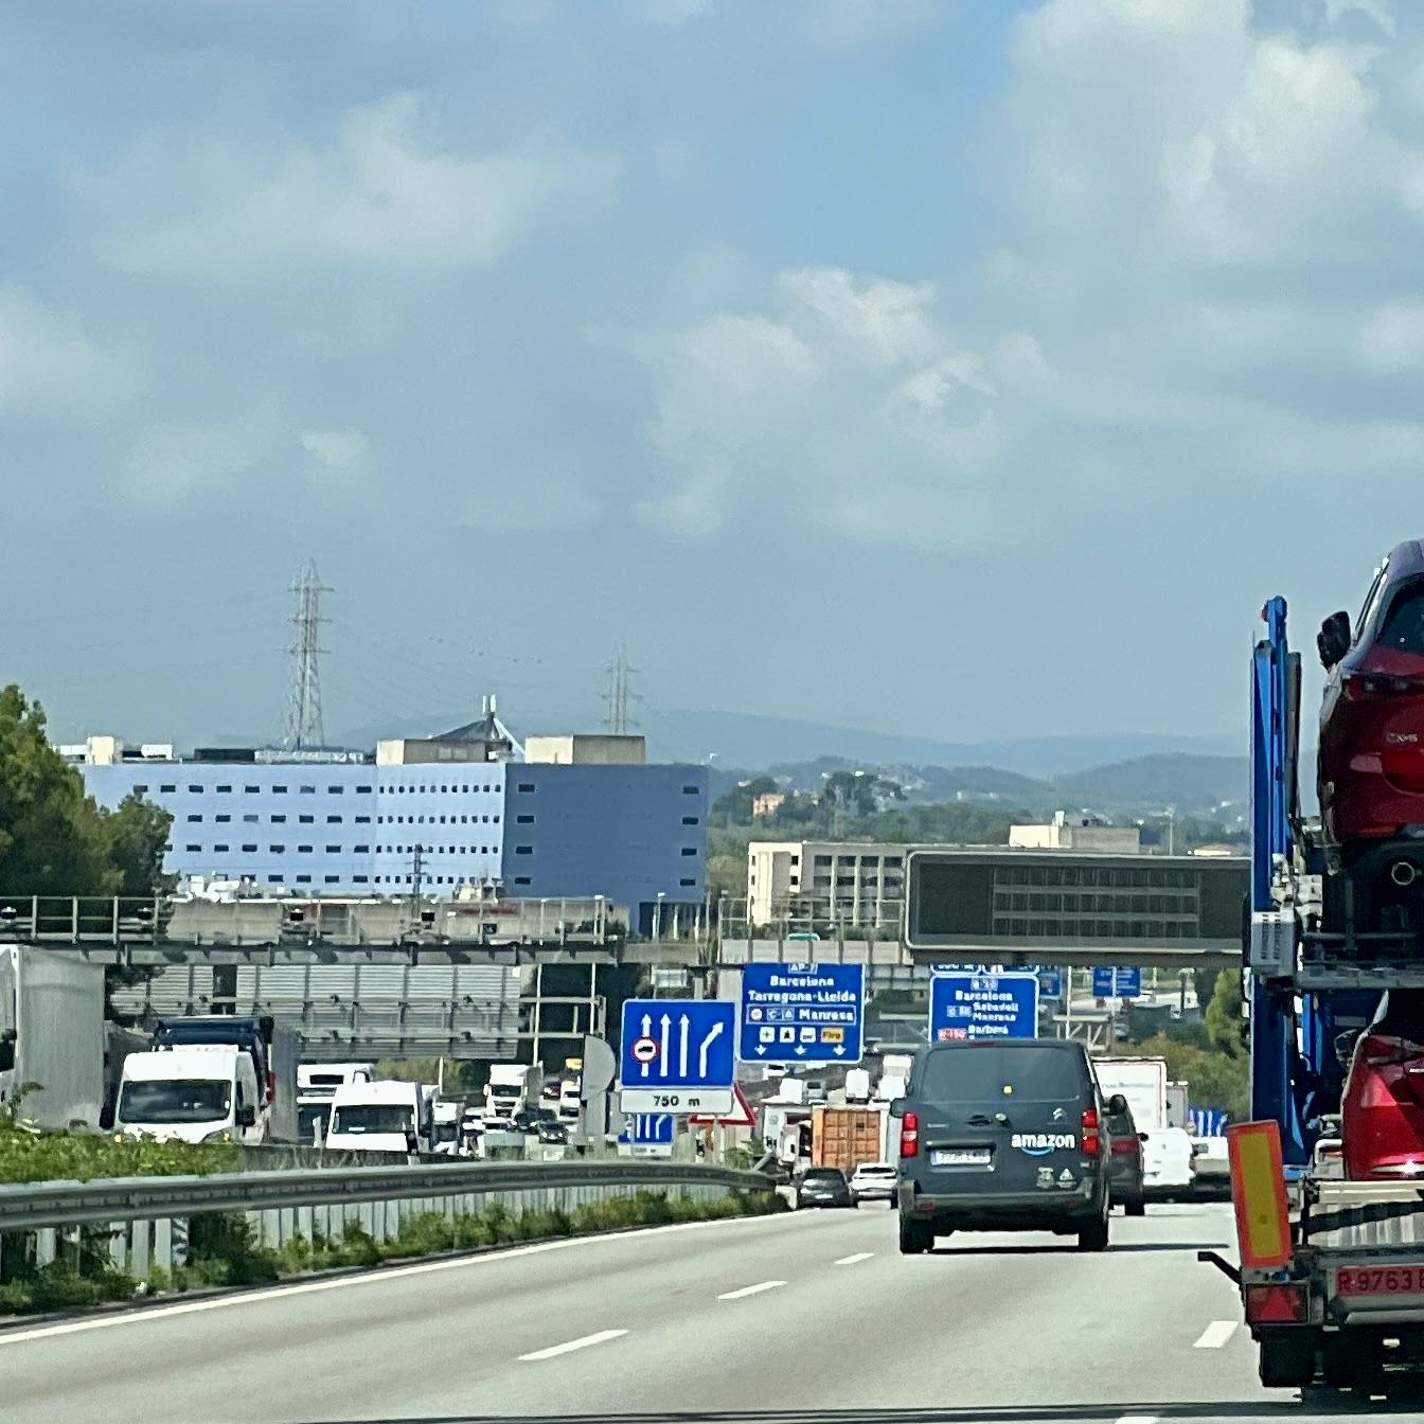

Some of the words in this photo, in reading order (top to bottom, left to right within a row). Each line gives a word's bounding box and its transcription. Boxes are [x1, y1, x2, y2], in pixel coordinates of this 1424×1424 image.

[653, 1095, 680, 1107] 750
[688, 1097, 701, 1107] m
[1011, 1133, 1076, 1149] amazon
